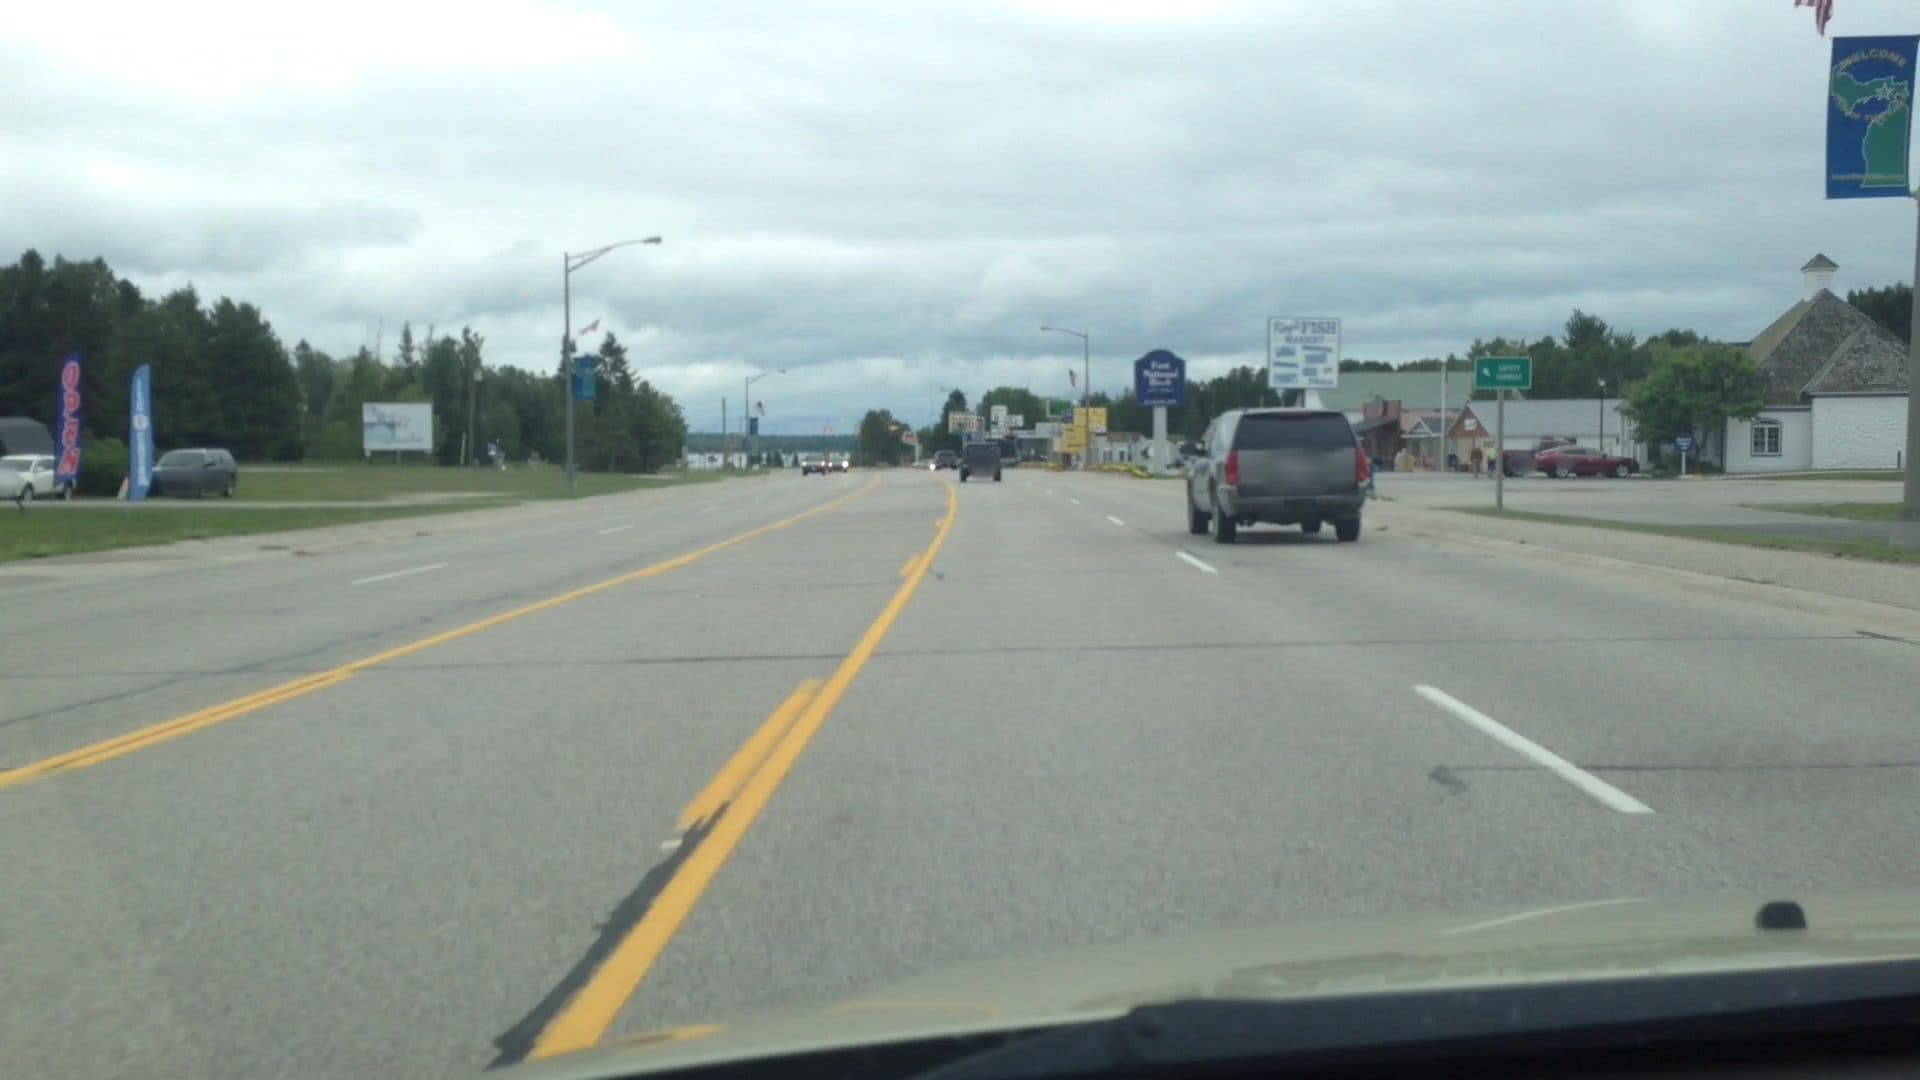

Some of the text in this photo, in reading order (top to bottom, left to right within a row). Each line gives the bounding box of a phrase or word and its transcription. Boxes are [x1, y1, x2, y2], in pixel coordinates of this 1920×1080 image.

[1838, 49, 1907, 73] WELCOME
[1301, 320, 1337, 335] FISH
[1143, 368, 1179, 378] National
[58, 361, 81, 475] OPEN
